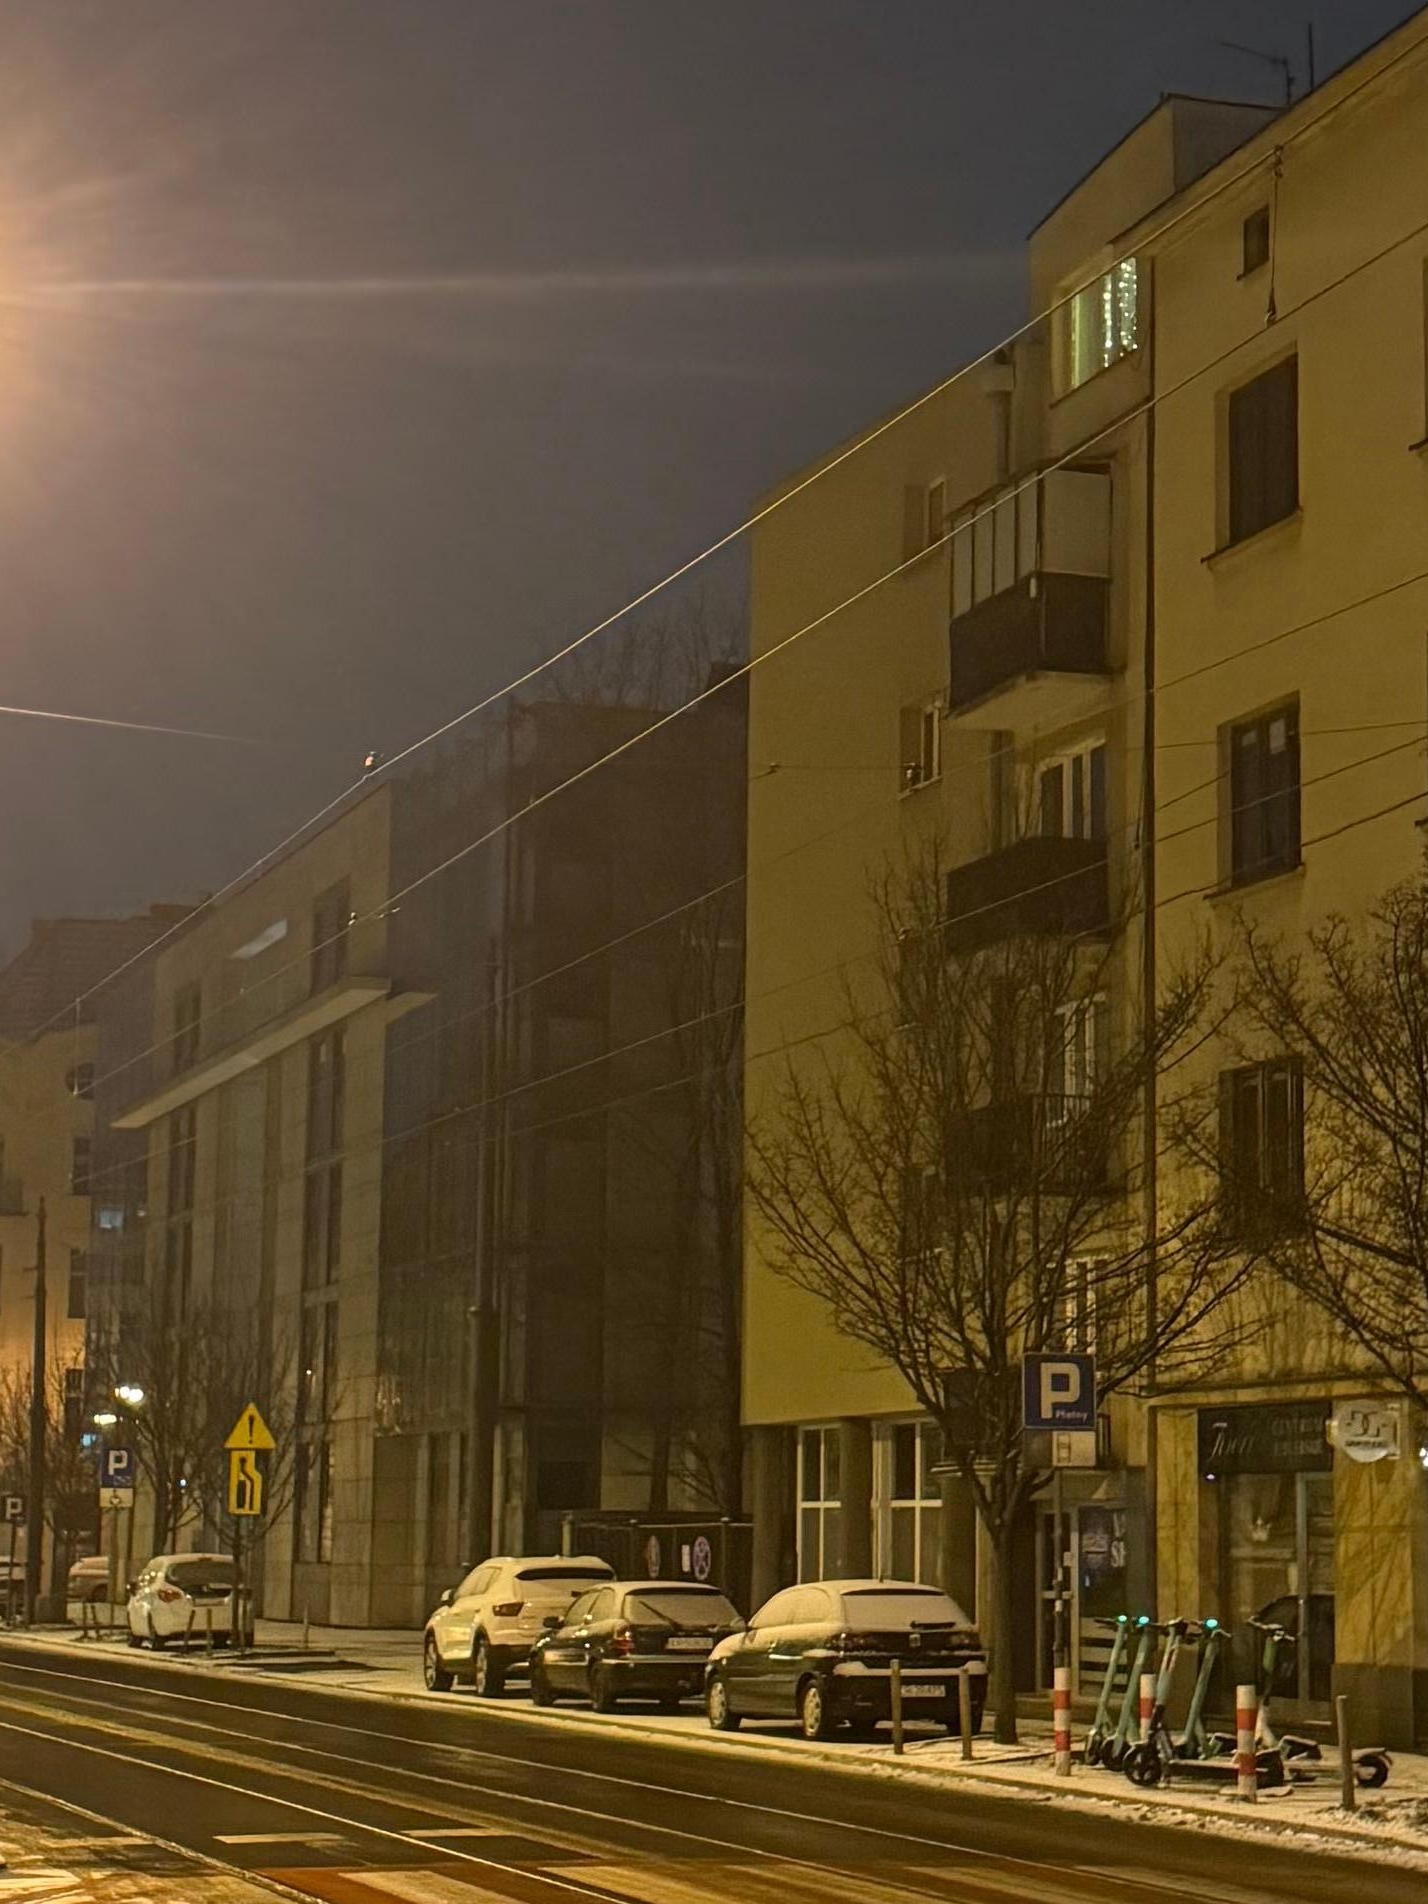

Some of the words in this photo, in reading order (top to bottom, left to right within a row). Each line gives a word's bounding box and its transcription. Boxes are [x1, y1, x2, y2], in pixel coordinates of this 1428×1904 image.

[1040, 1362, 1080, 1419] P
[108, 1450, 128, 1476] P
[5, 1497, 22, 1520] P
